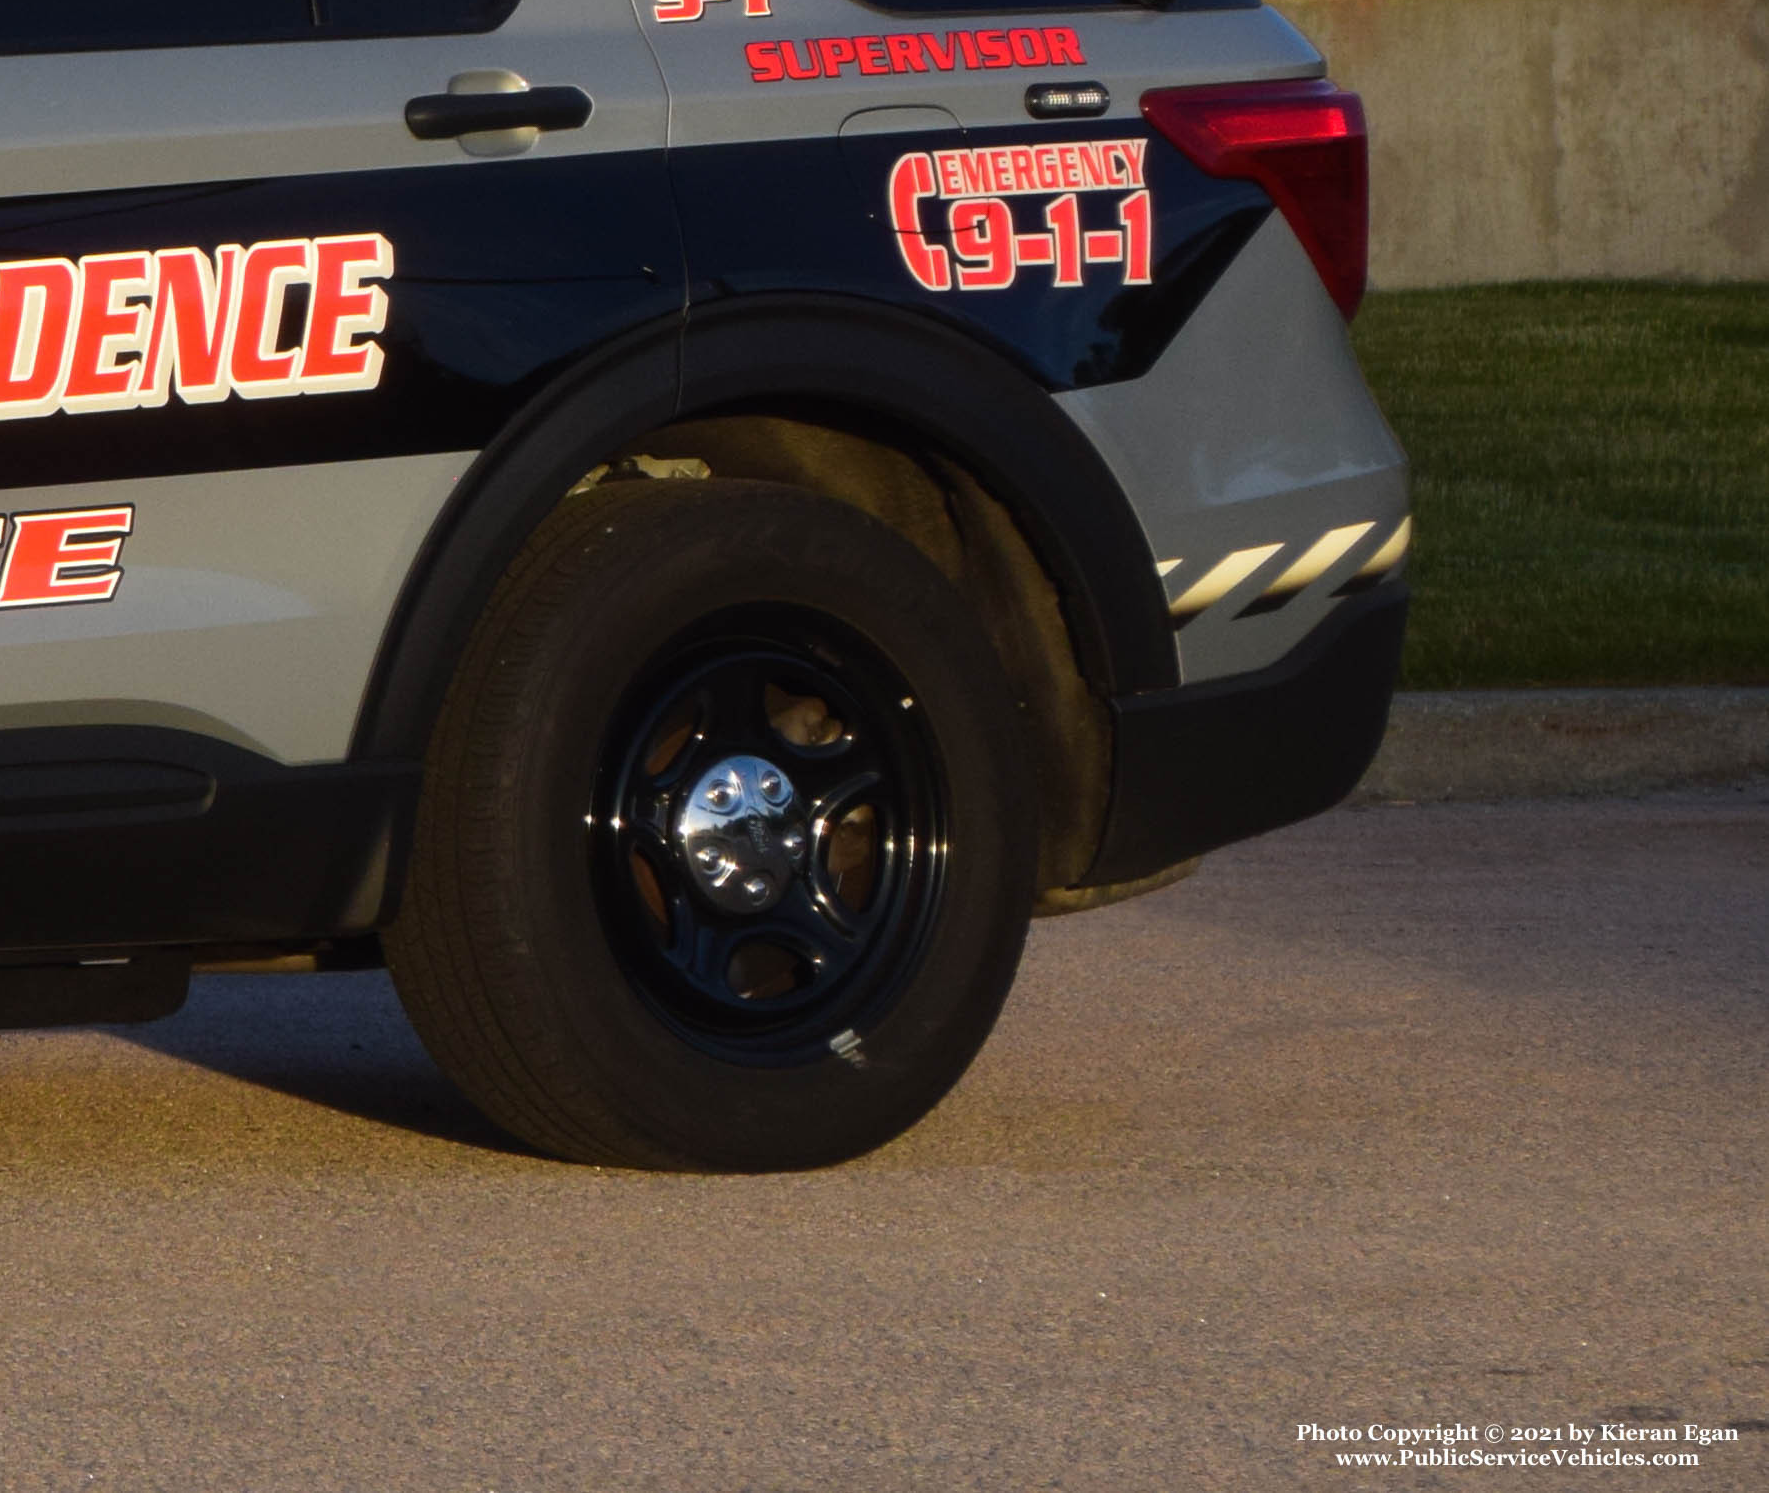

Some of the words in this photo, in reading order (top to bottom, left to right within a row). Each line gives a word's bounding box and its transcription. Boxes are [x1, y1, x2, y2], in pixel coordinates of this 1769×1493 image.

[745, 27, 1086, 83] SUPERVISOR
[932, 138, 1148, 200] EMERGENCY
[949, 190, 1152, 290] 9-1-1
